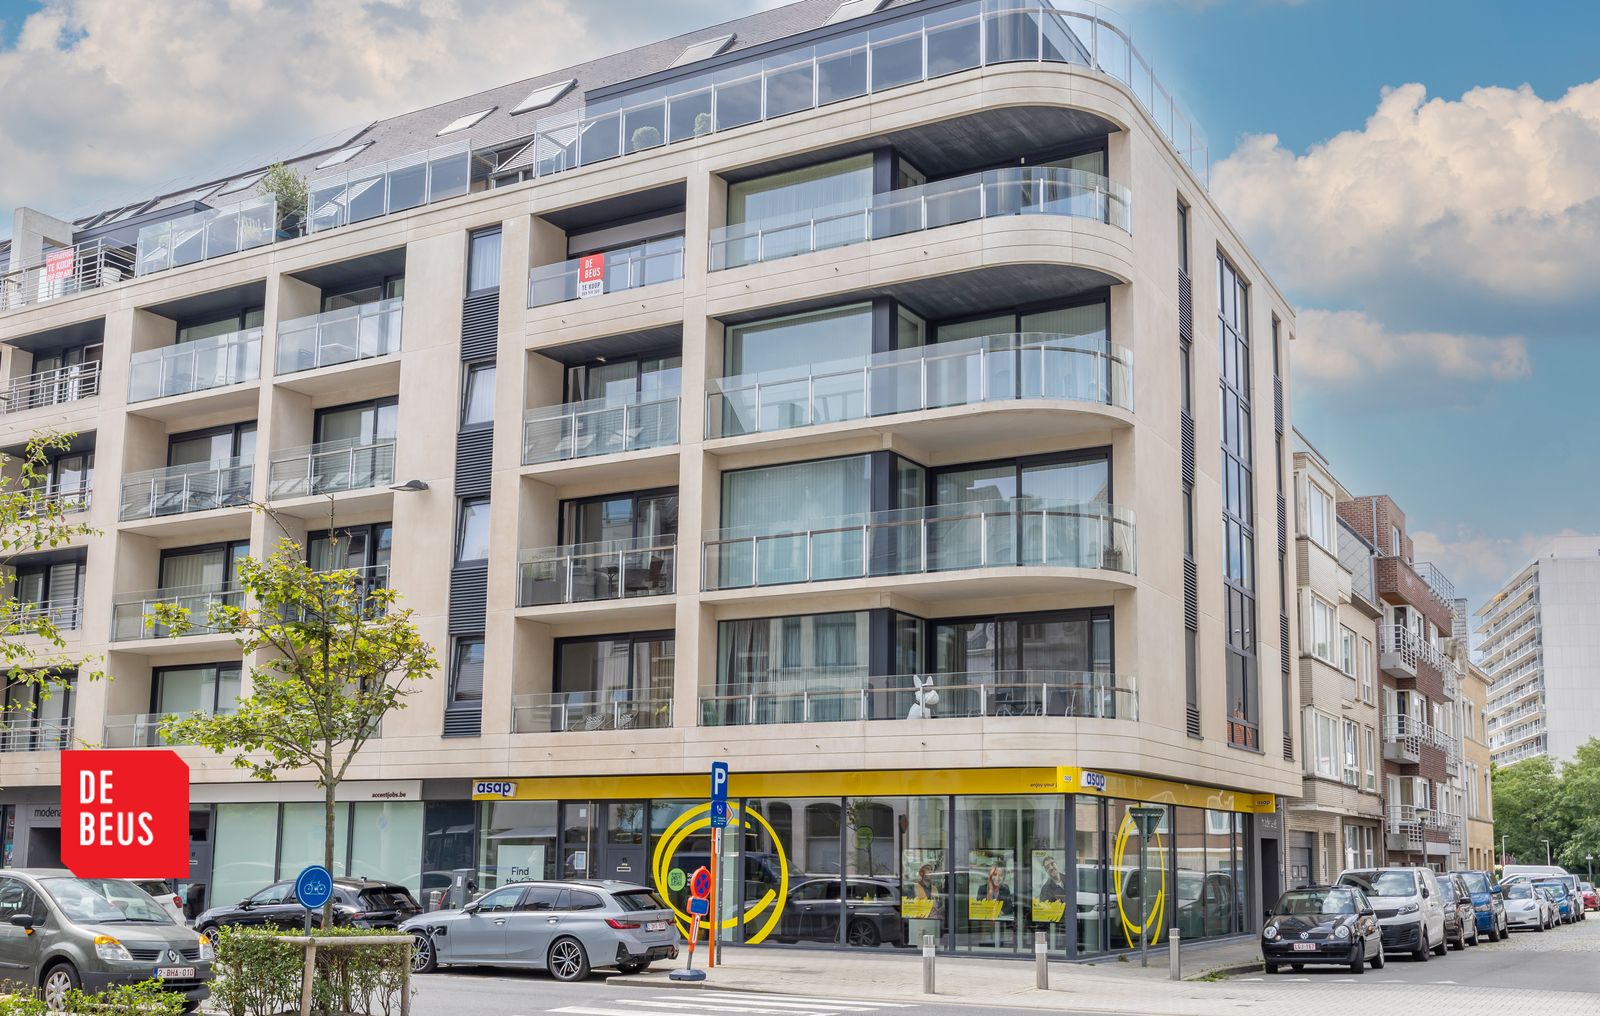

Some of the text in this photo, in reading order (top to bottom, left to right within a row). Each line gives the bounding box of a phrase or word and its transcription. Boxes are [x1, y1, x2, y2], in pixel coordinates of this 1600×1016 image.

[48, 264, 55, 273] TE
[585, 259, 592, 269] DE
[584, 268, 600, 278] BEUS
[589, 282, 600, 290] KOOP
[714, 768, 726, 794] P
[1086, 773, 1105, 792] asap
[477, 782, 511, 797] asap
[512, 867, 529, 875] Find
